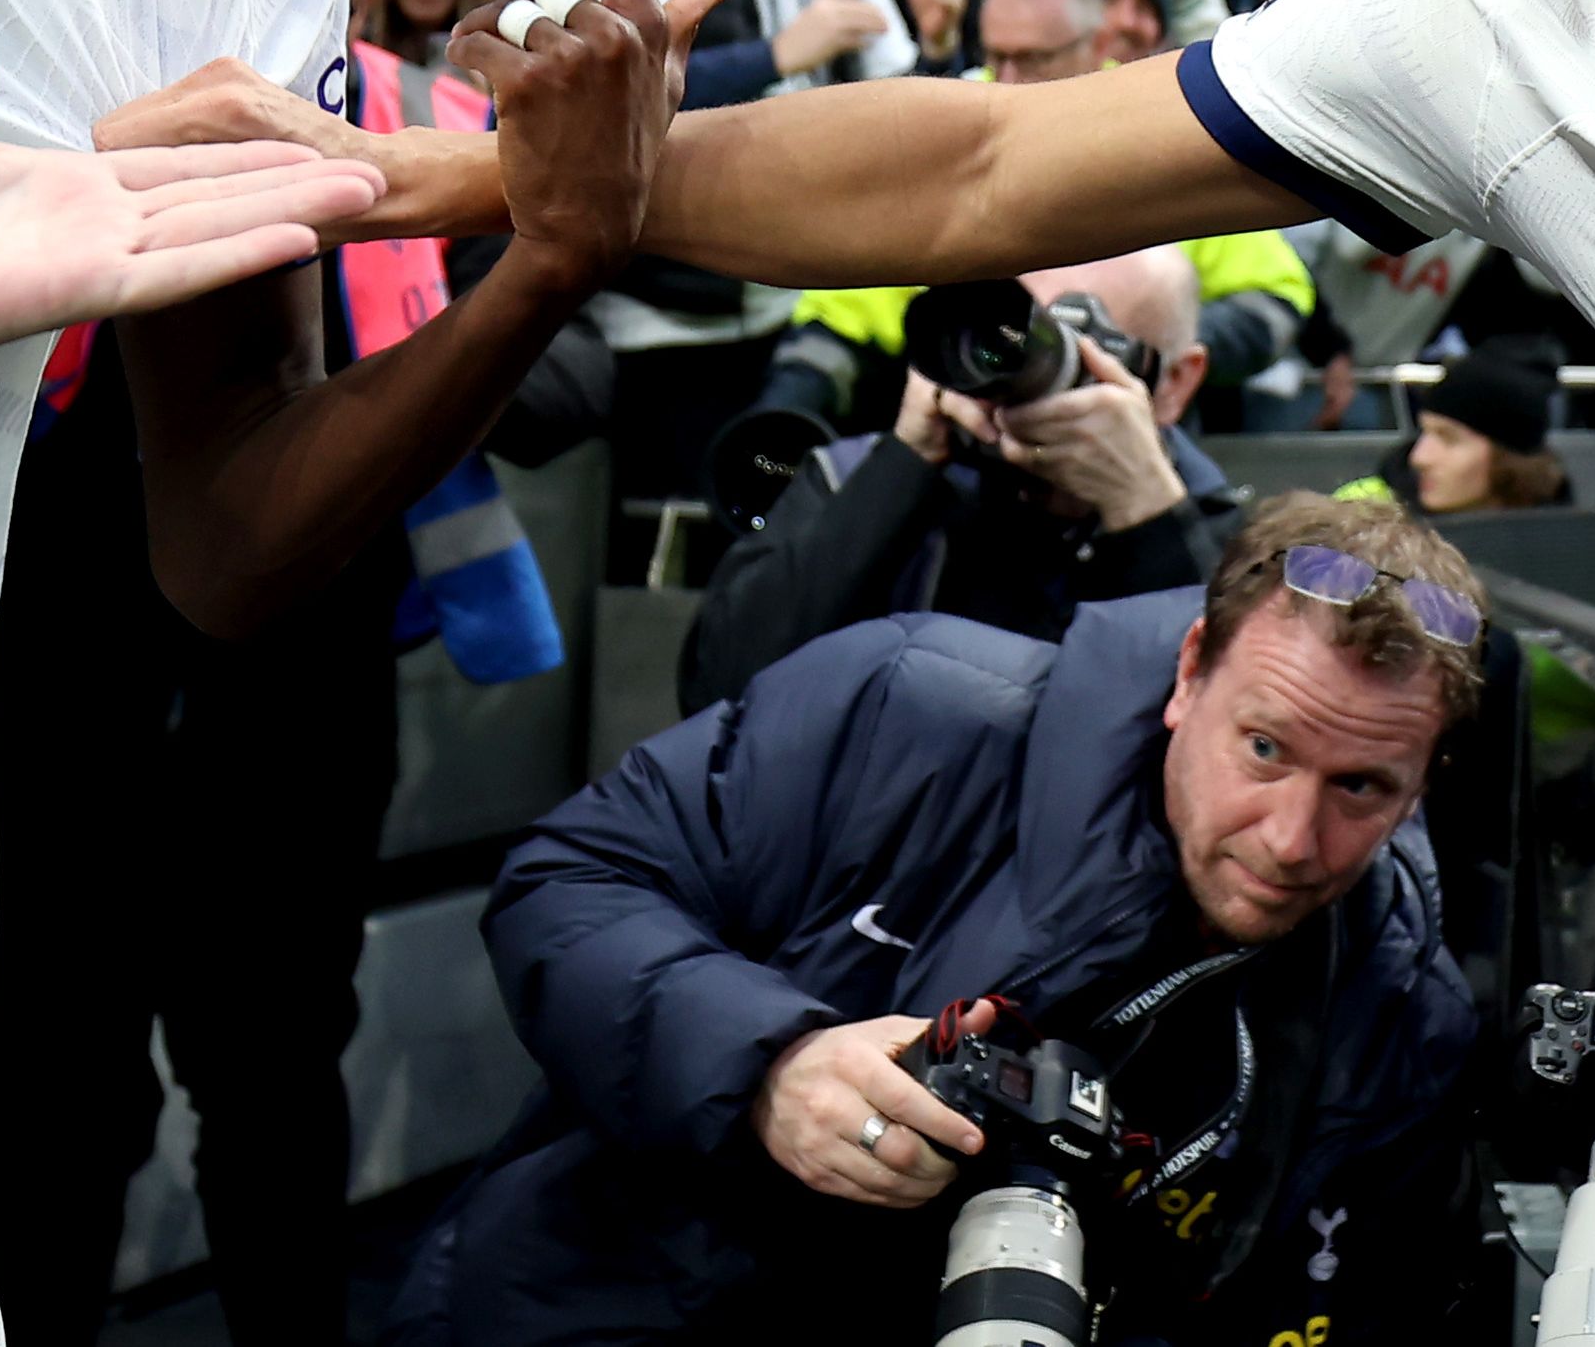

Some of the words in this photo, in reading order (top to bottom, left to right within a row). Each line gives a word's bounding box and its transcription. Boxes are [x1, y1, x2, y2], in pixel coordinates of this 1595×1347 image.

[1113, 969, 1190, 1026] TOTTENHAM
[1048, 1133, 1093, 1160] Canon
[1161, 1130, 1222, 1179] HOTSPUR
